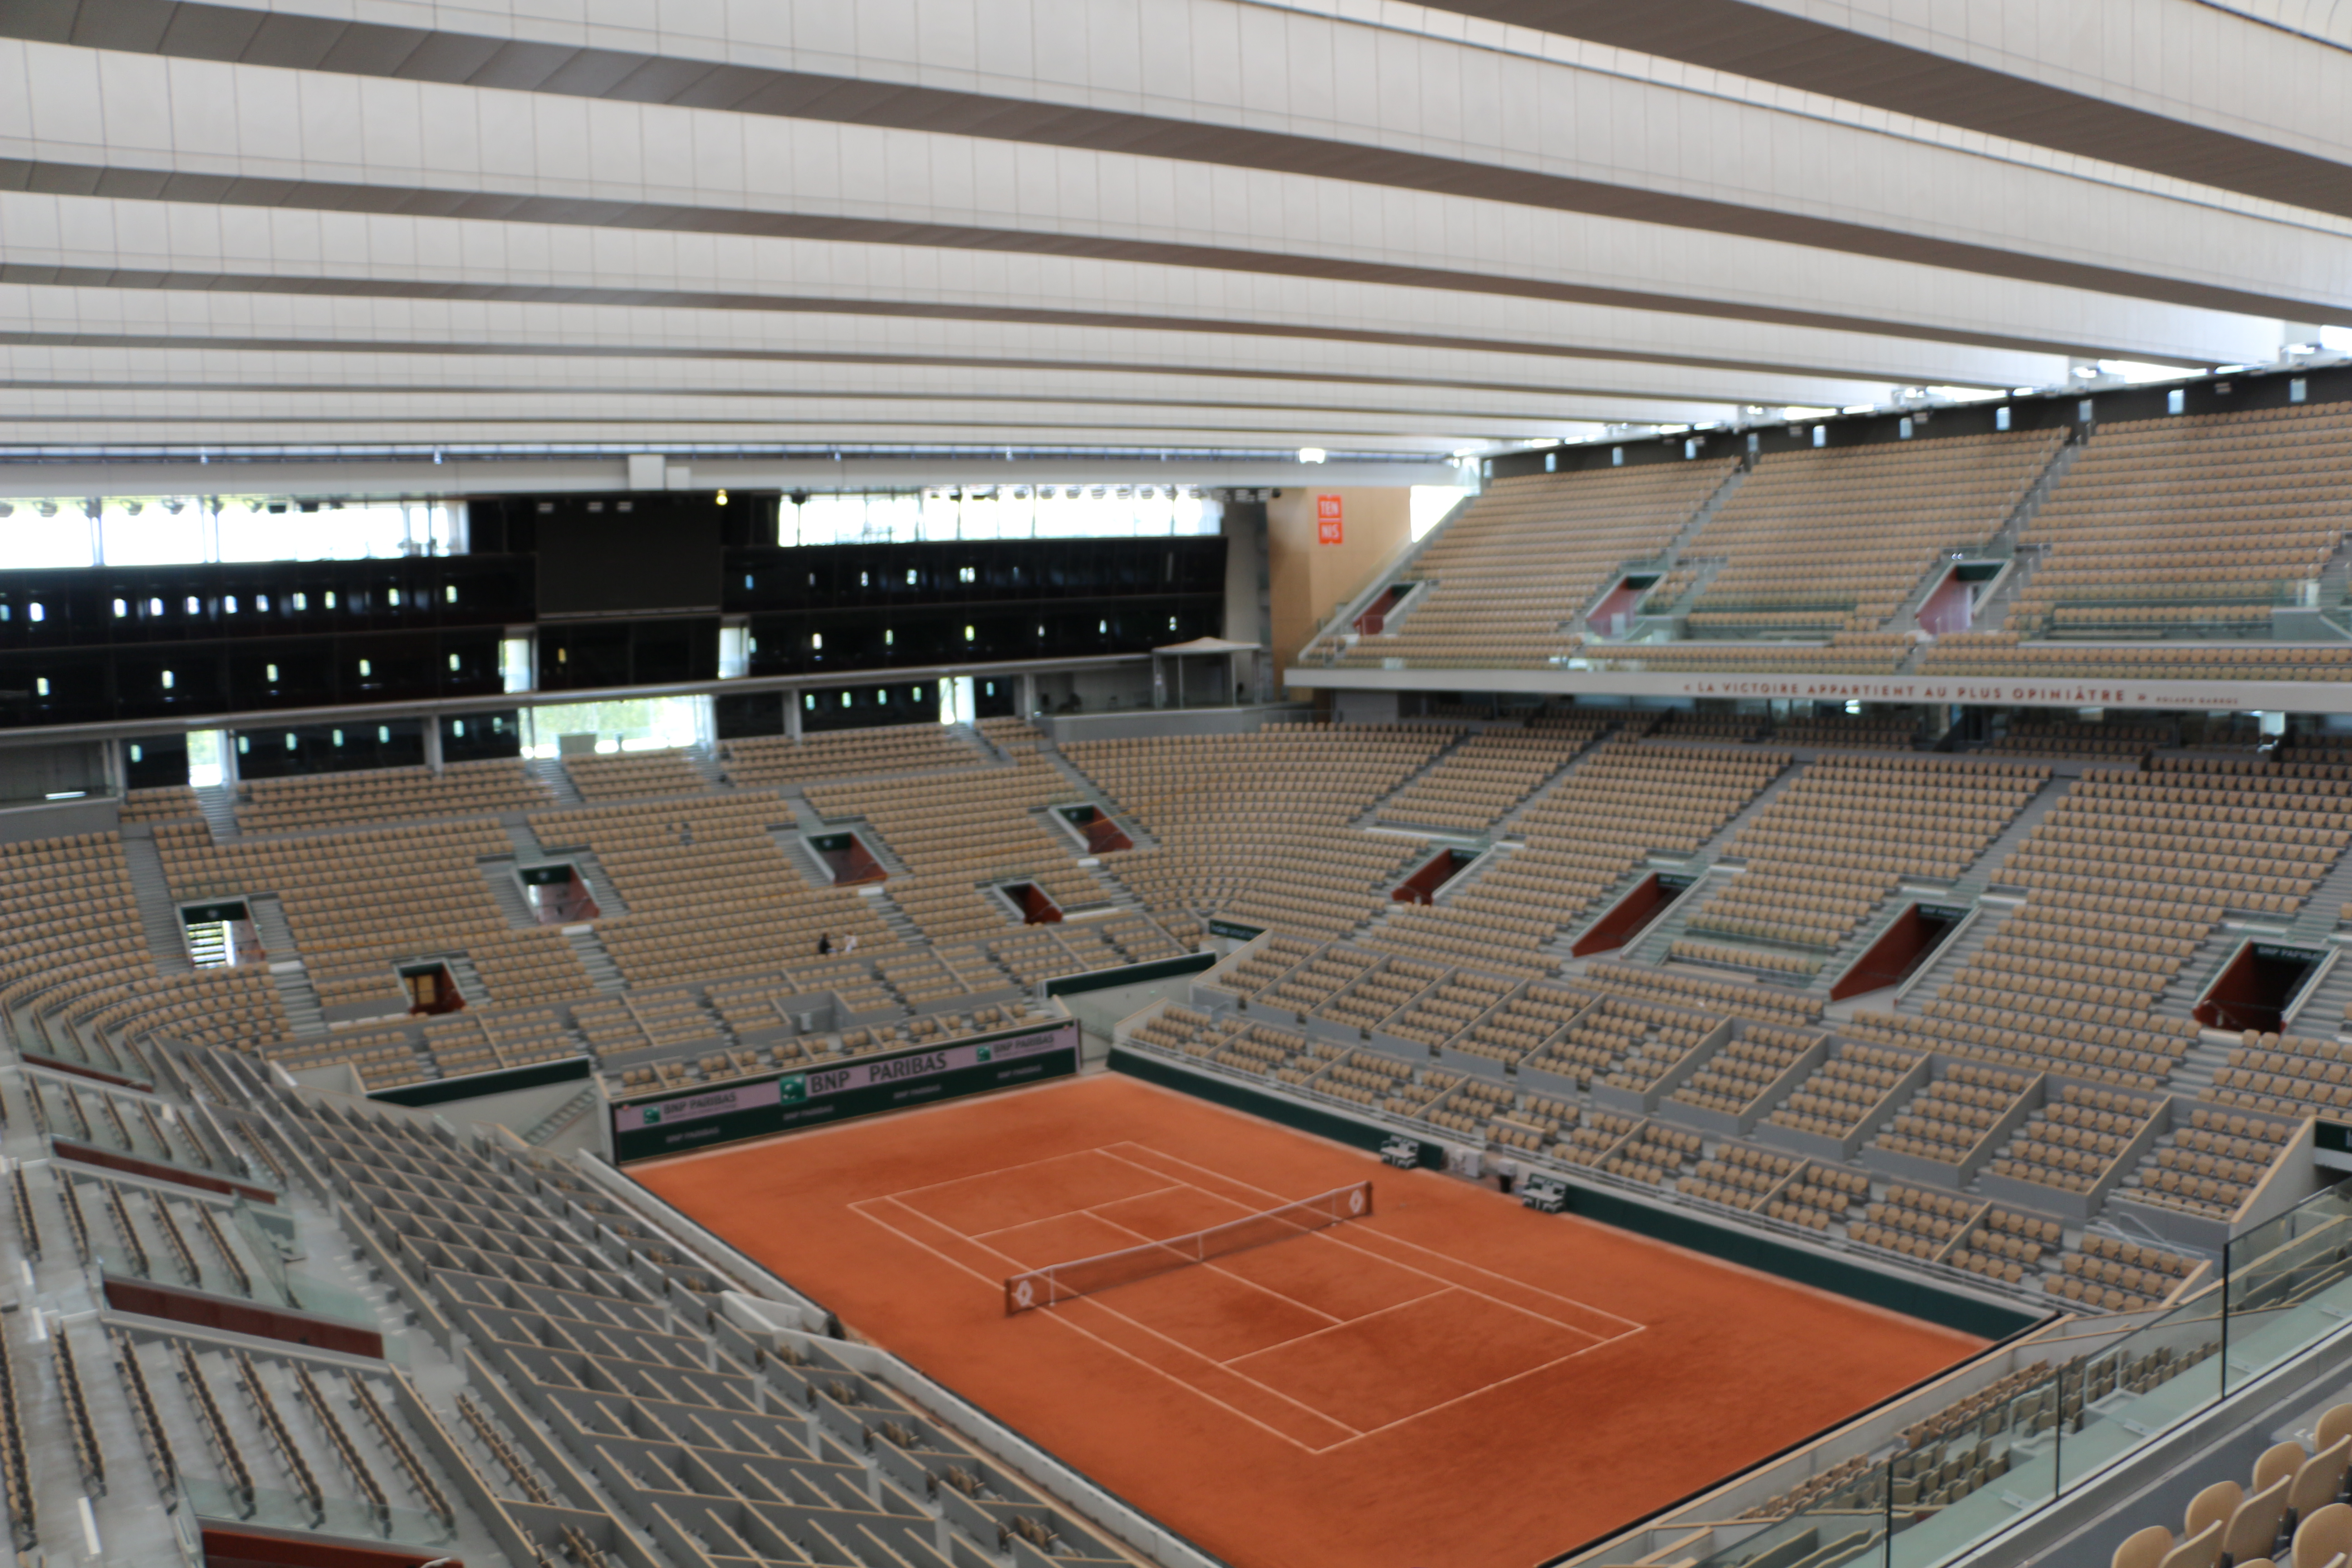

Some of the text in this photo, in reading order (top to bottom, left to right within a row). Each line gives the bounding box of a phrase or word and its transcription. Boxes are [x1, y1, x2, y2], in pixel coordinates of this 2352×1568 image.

[1698, 681, 1715, 692] LA
[1723, 682, 1798, 694] VICTOIRE
[1807, 684, 1914, 696] APPARTIENT
[1924, 686, 1946, 697] AU
[1957, 687, 2001, 699] PLUS
[2013, 686, 2124, 701] OPINIÂTRE
[811, 1052, 946, 1093] BNP PARIBAS
[664, 1102, 686, 1114] BNP
[690, 1091, 736, 1109] PARIBAS
